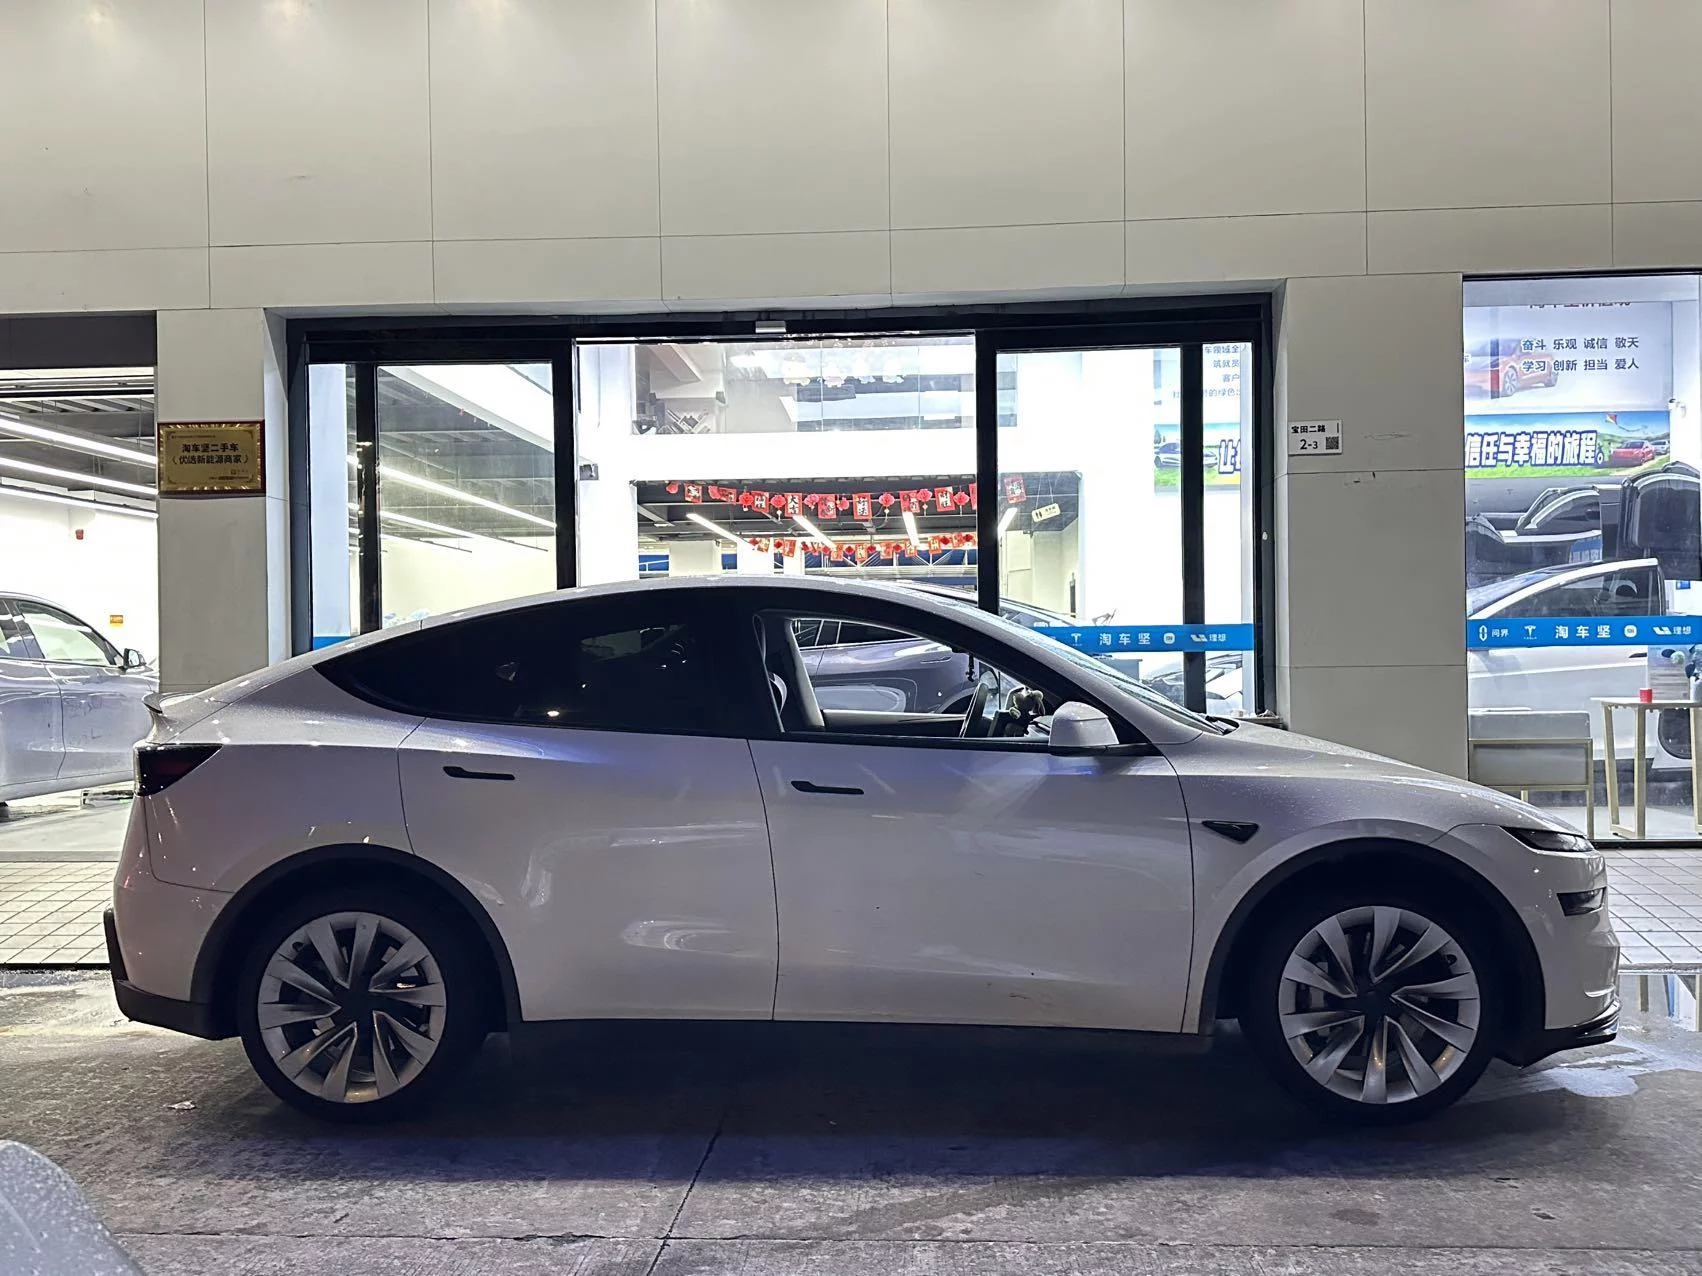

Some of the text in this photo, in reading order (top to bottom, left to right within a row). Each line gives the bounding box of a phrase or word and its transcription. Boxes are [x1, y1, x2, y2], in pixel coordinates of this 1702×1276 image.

[1522, 336, 1639, 351] 奋斗 乐观 诚信 敬天
[1522, 358, 1639, 372] 学习 创新 担当 爱人
[1291, 424, 1326, 434] 宝田二路
[1300, 438, 1319, 450] 2-3
[1491, 628, 1509, 638] 问界
[1555, 624, 1611, 639] 淘车坚
[1673, 626, 1692, 635] 理想
[1099, 632, 1151, 646] 淘车坚
